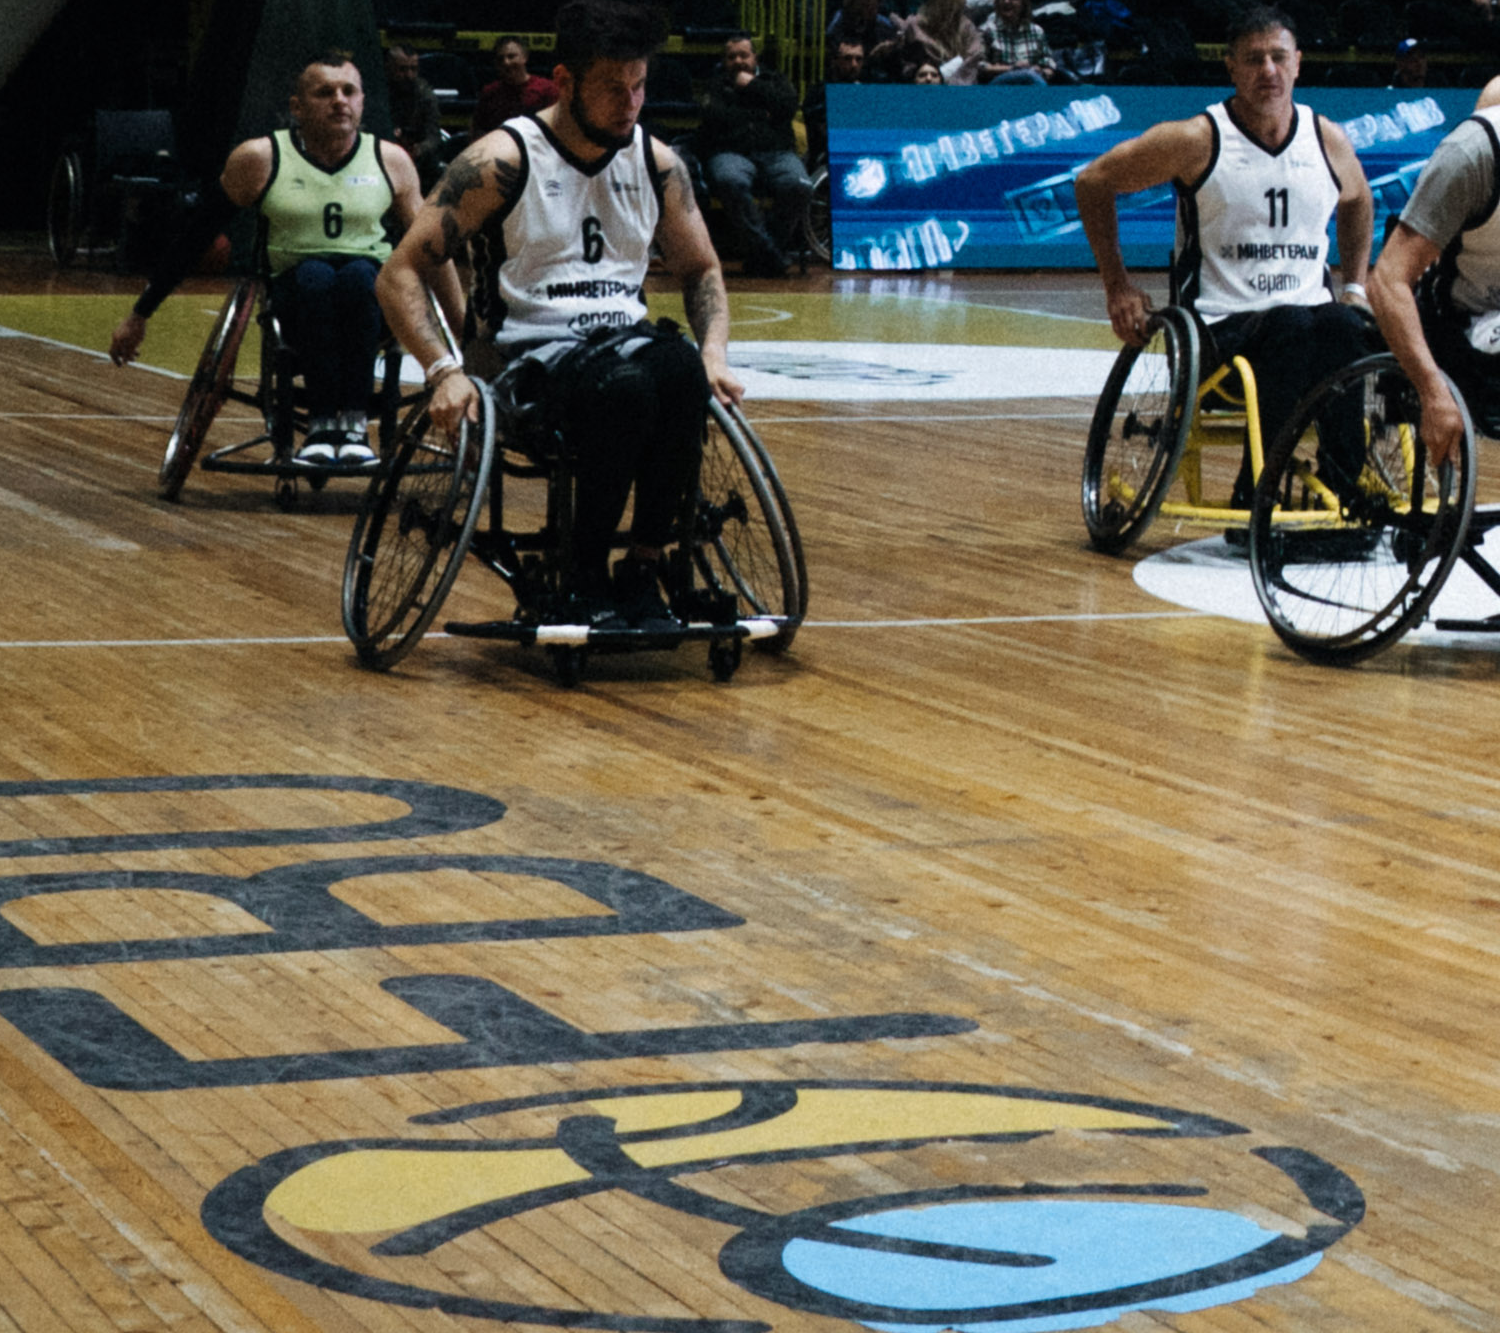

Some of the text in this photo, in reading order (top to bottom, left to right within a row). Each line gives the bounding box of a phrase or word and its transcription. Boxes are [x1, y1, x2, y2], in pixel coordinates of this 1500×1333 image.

[323, 203, 343, 238] 6
[1264, 187, 1288, 227] 11
[582, 216, 603, 263] 6
